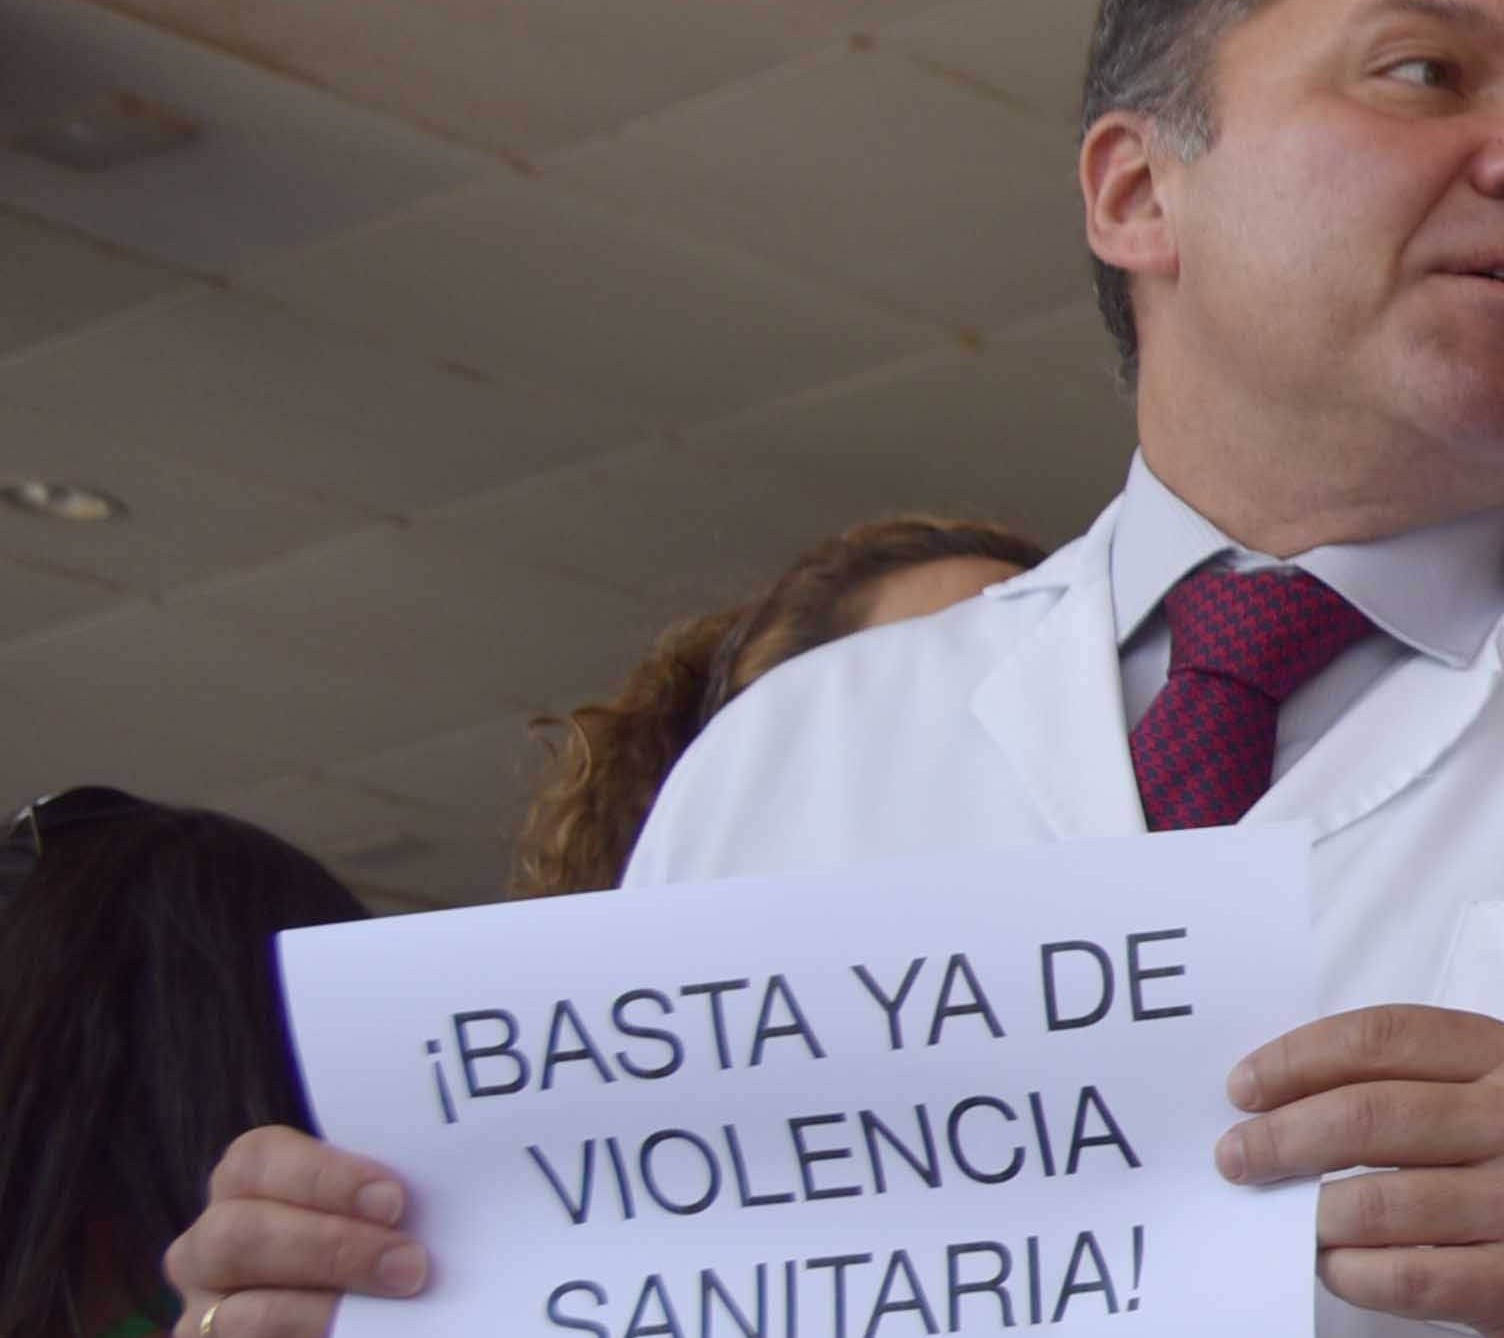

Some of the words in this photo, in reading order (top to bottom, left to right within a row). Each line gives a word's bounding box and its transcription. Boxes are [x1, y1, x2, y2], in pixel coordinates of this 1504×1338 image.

[423, 973, 824, 1124] ¡BASTA
[850, 952, 1004, 1051] YA
[1039, 927, 1194, 1033] DE
[525, 1085, 1142, 1226] VIOLENCIA
